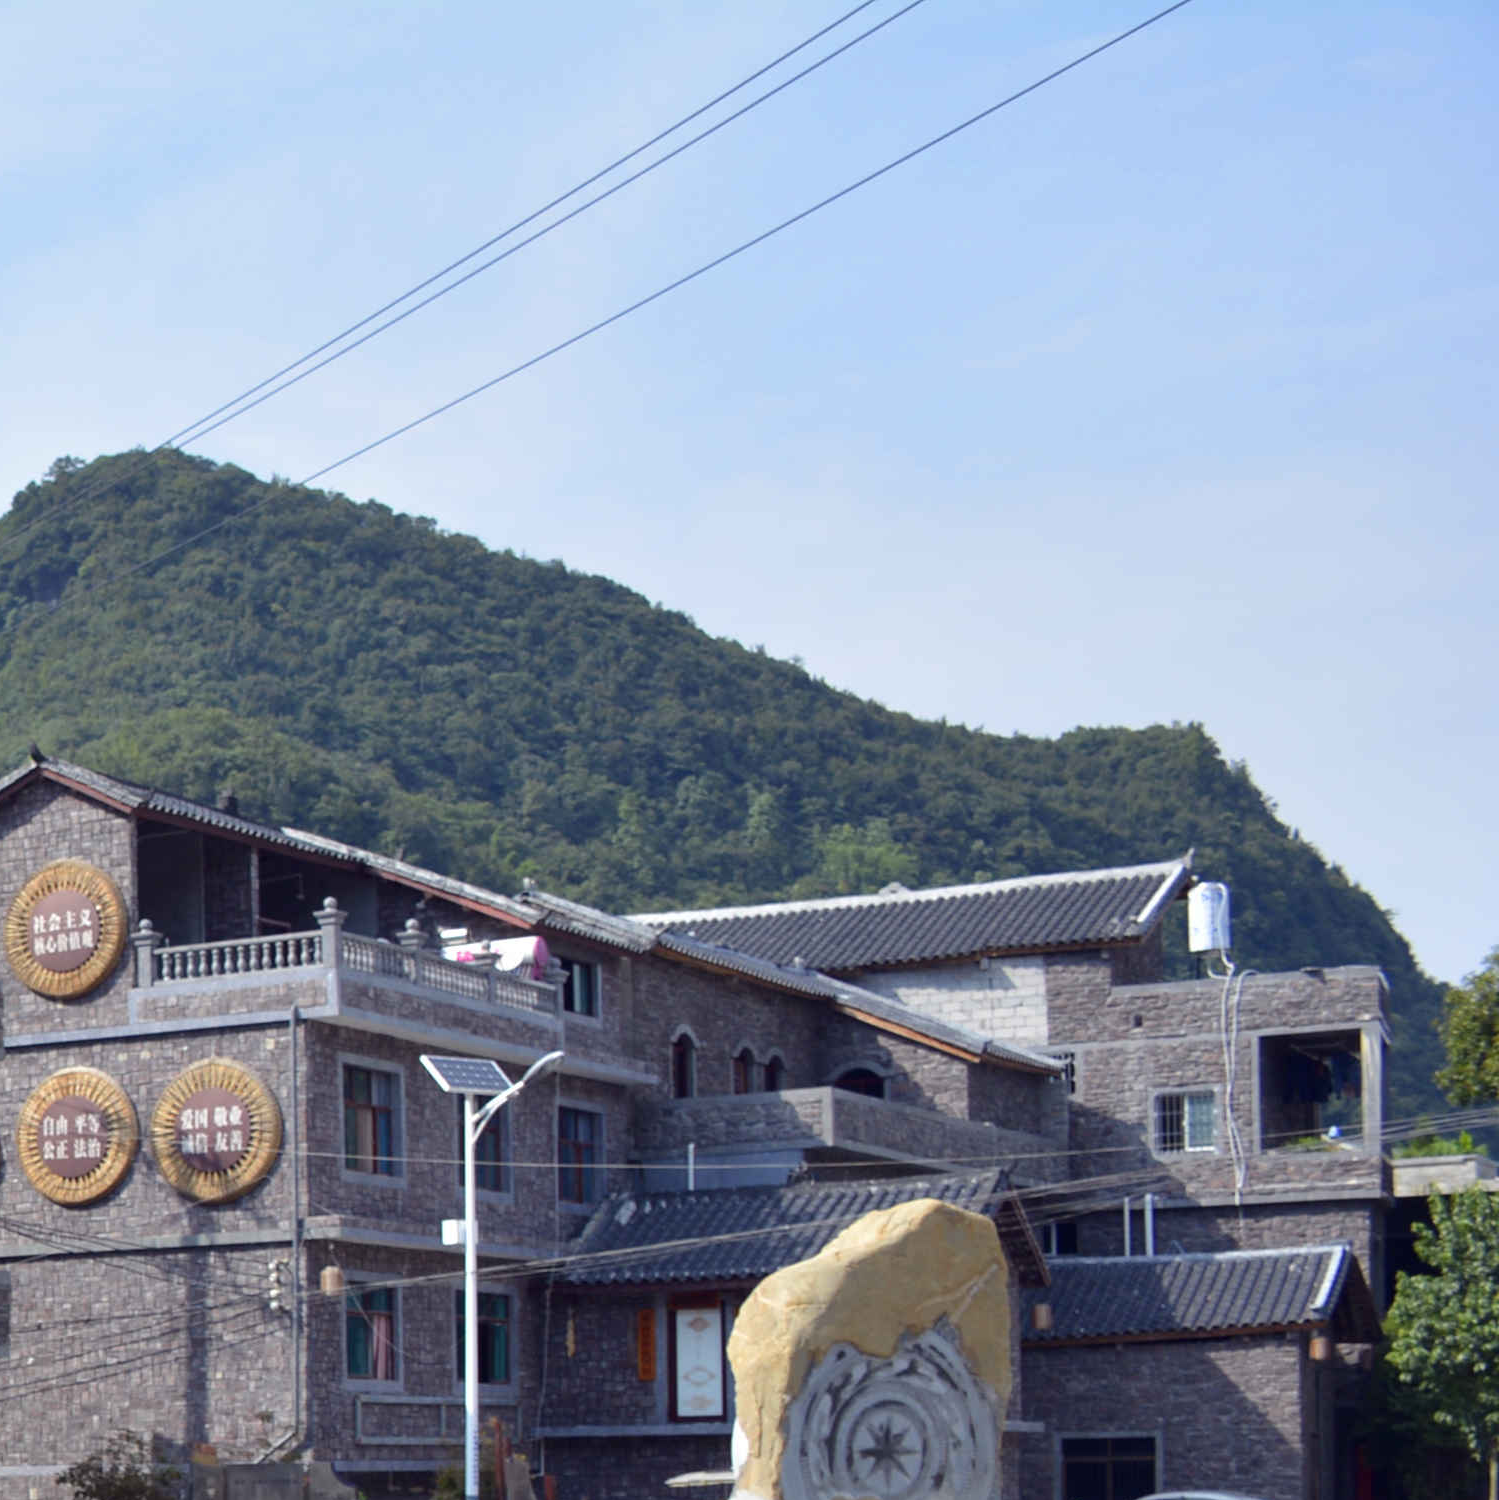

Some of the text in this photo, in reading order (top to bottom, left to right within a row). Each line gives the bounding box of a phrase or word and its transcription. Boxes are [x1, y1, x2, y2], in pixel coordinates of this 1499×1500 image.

[33, 909, 92, 934] 社会主义
[34, 930, 93, 956] 核心价值观
[43, 1113, 100, 1137] 自由 平等
[181, 1105, 243, 1130] 爱国 敬业
[43, 1138, 101, 1160] 公正 法治
[214, 1130, 243, 1152] 友善
